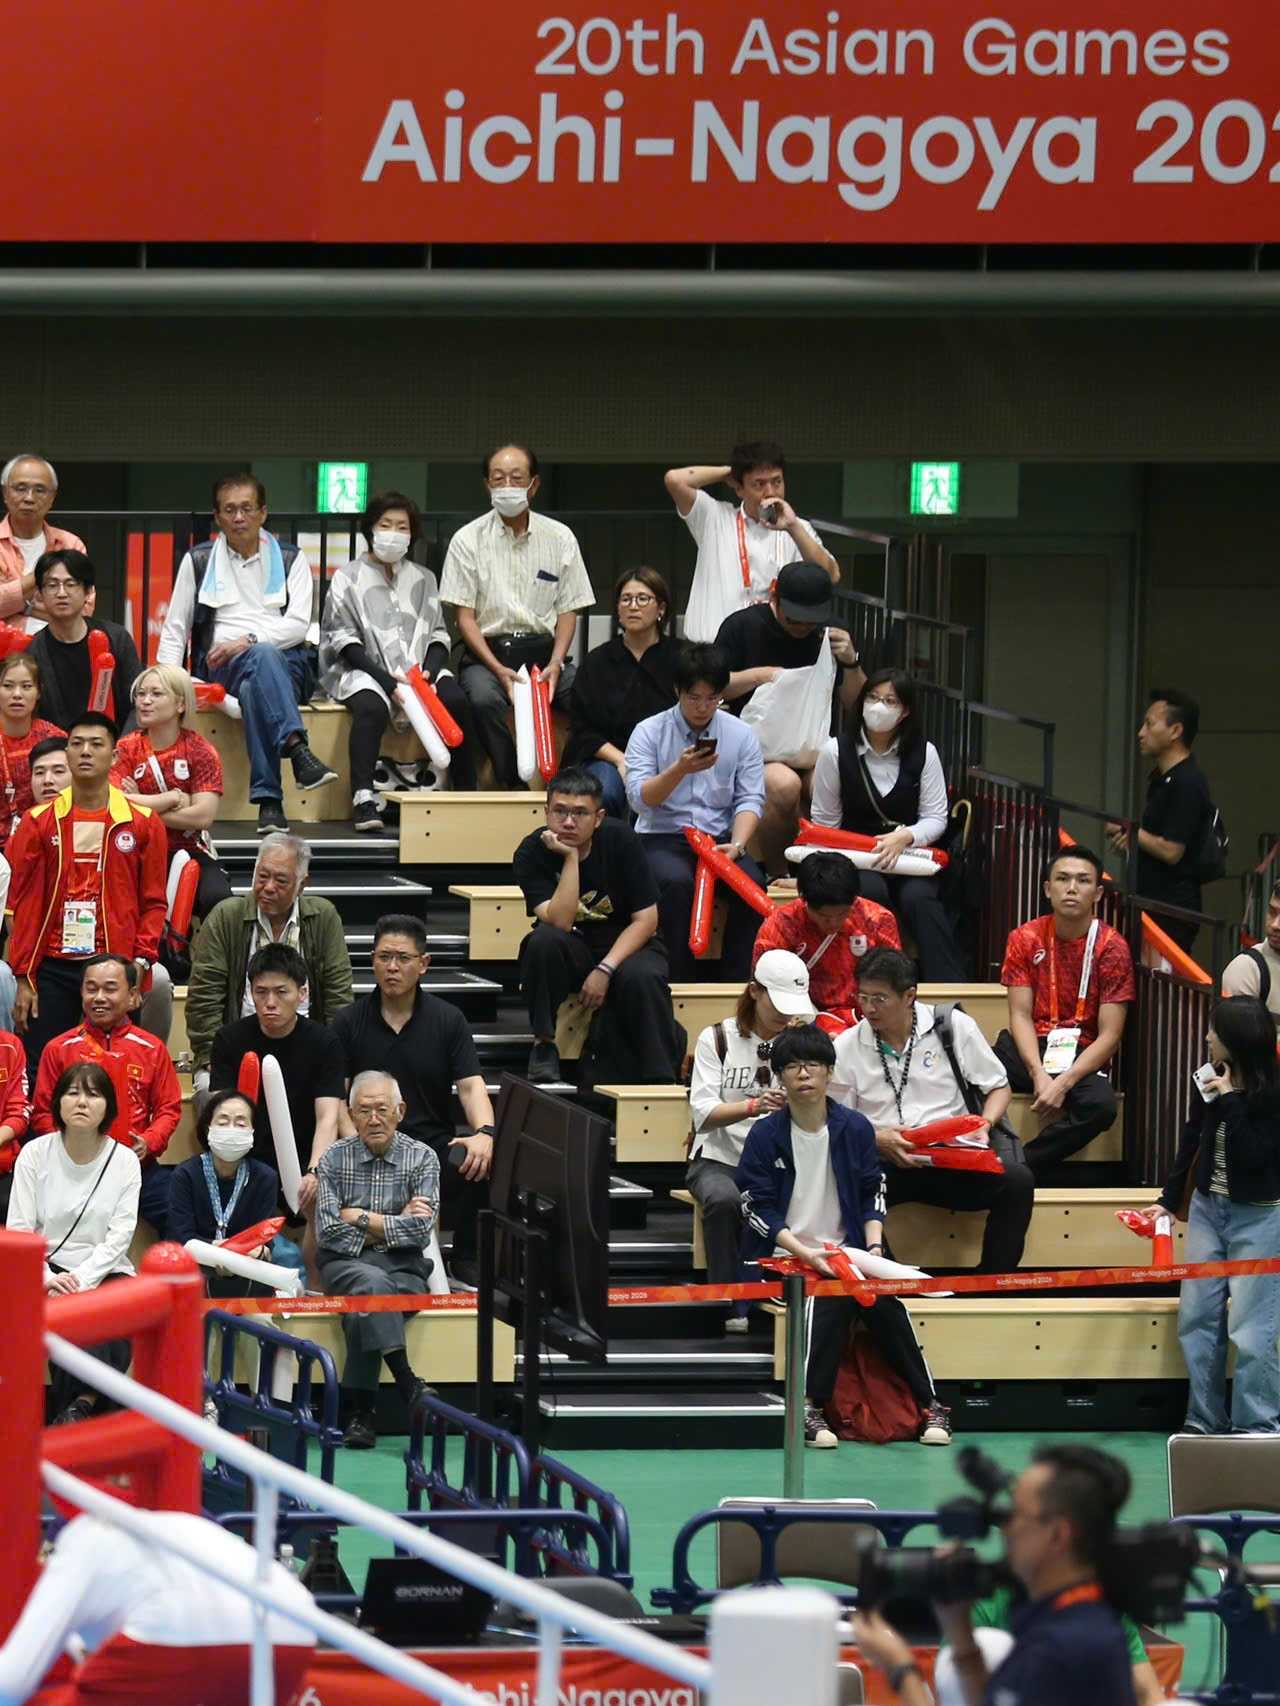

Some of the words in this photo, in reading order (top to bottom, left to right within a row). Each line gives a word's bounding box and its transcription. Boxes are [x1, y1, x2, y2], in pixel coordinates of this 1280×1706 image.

[535, 12, 705, 76] 20th
[730, 10, 935, 75] Asian
[963, 17, 1230, 76] Games
[361, 89, 1097, 211] Aichi-Nagoya
[1133, 99, 1280, 184] 20
